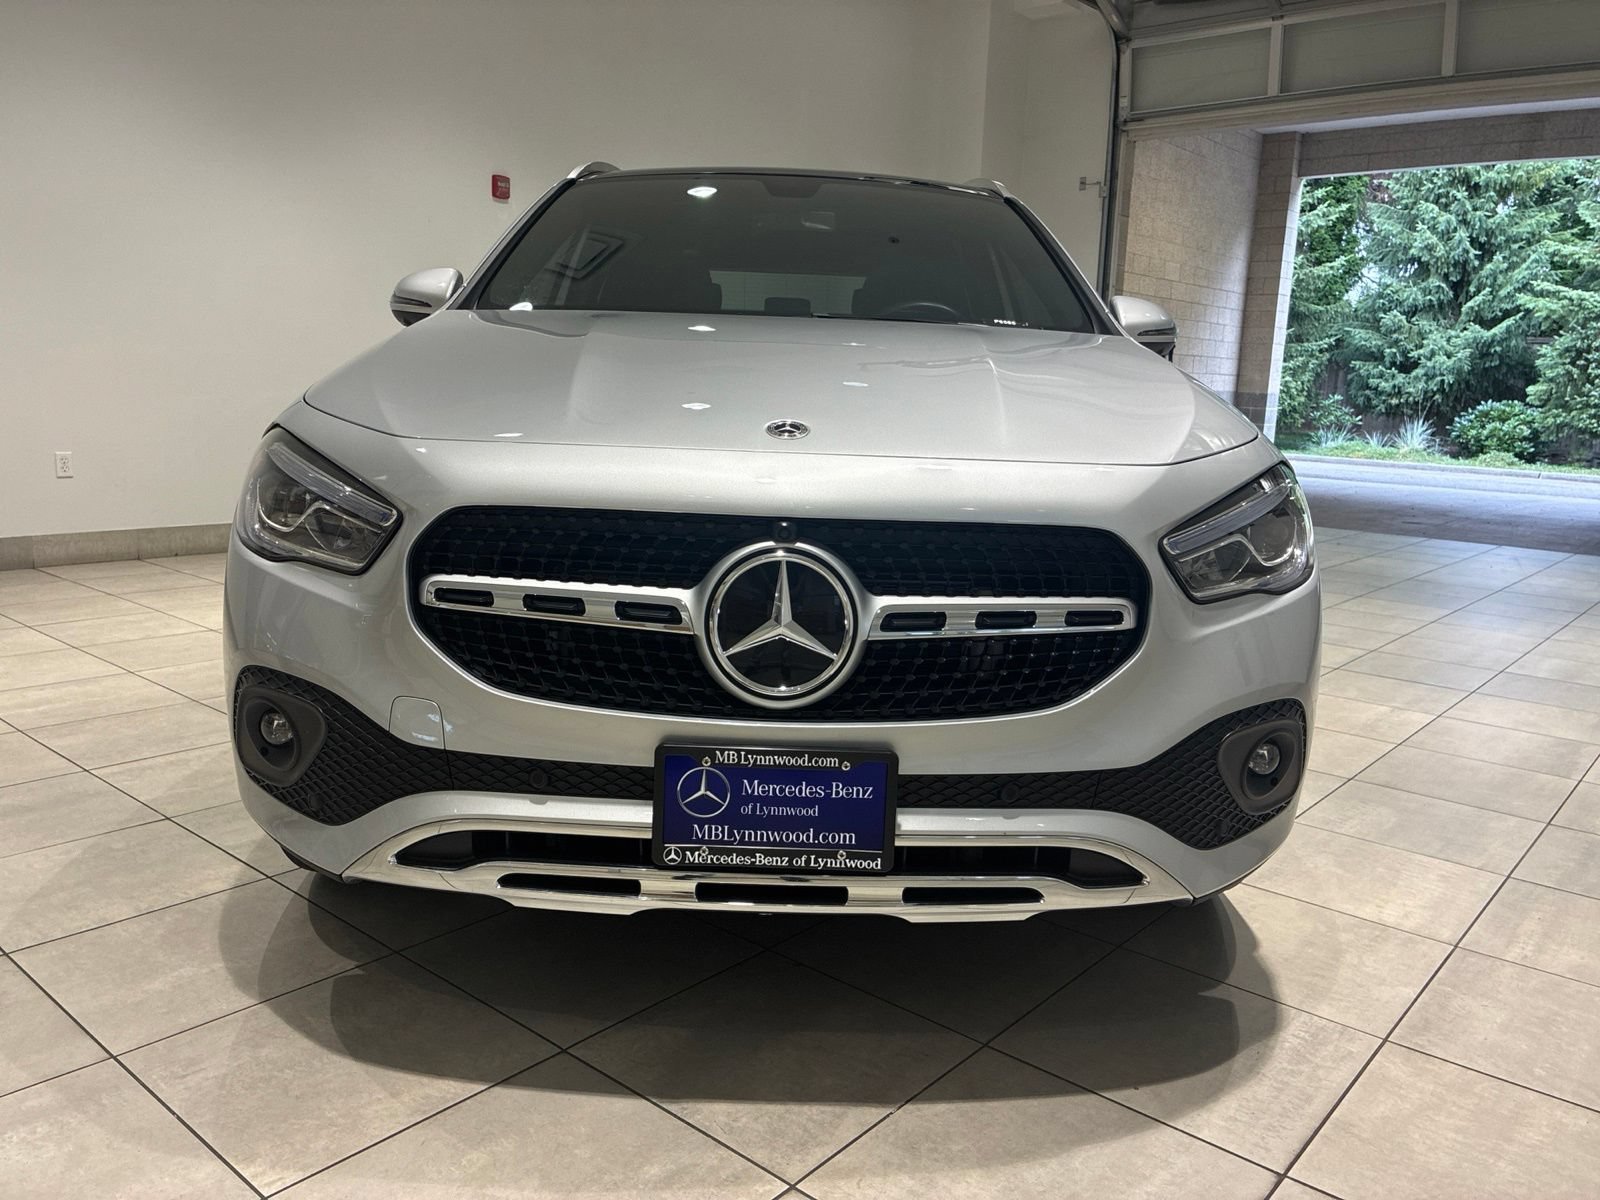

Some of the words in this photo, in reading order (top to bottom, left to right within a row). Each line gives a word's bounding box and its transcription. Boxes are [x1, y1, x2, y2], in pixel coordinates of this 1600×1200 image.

[742, 779, 873, 799] Mercedes-Benz
[740, 803, 754, 815] of
[756, 803, 819, 818] Lynnwood
[692, 823, 856, 845] MBLynnwood.com
[685, 850, 789, 866] Mercedes-Benz
[793, 854, 807, 866] of
[810, 854, 881, 870] Lynnwood
